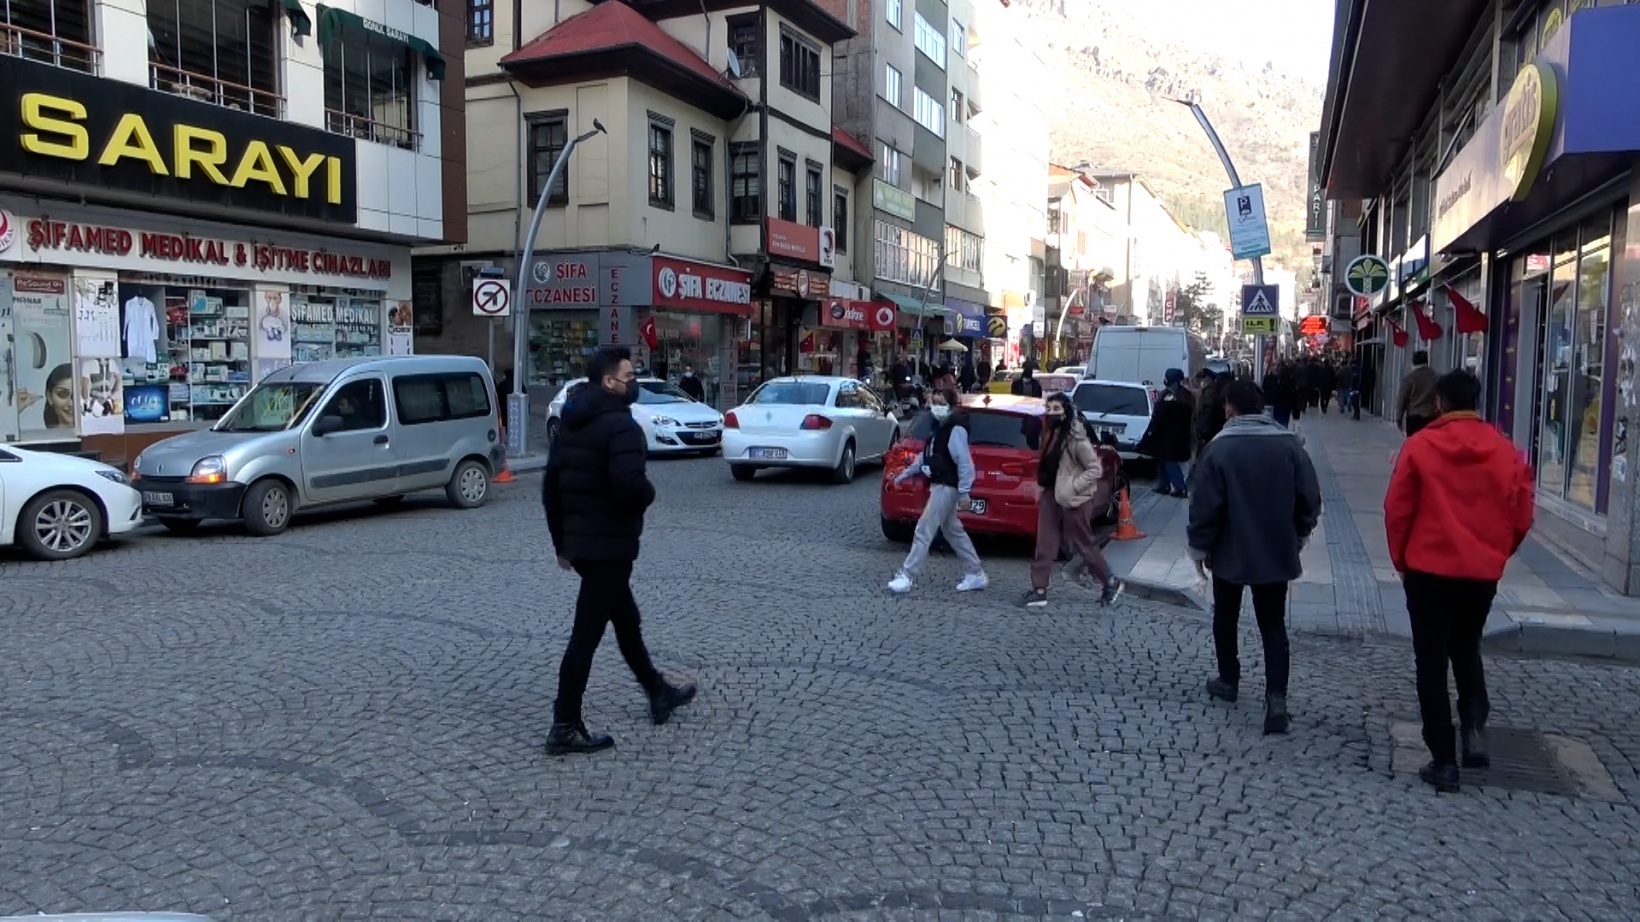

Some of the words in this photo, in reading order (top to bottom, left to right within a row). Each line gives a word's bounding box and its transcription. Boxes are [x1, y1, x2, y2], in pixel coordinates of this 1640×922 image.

[20, 93, 342, 205] SARAYI
[28, 218, 134, 255] ŞİFAMED
[140, 229, 230, 268] MEDİKAL
[234, 243, 248, 267] &
[556, 260, 587, 283] ŞİFA
[678, 267, 703, 299] ŞİFA
[705, 278, 751, 304] ECZANESİ
[610, 269, 619, 343] ECZANE
